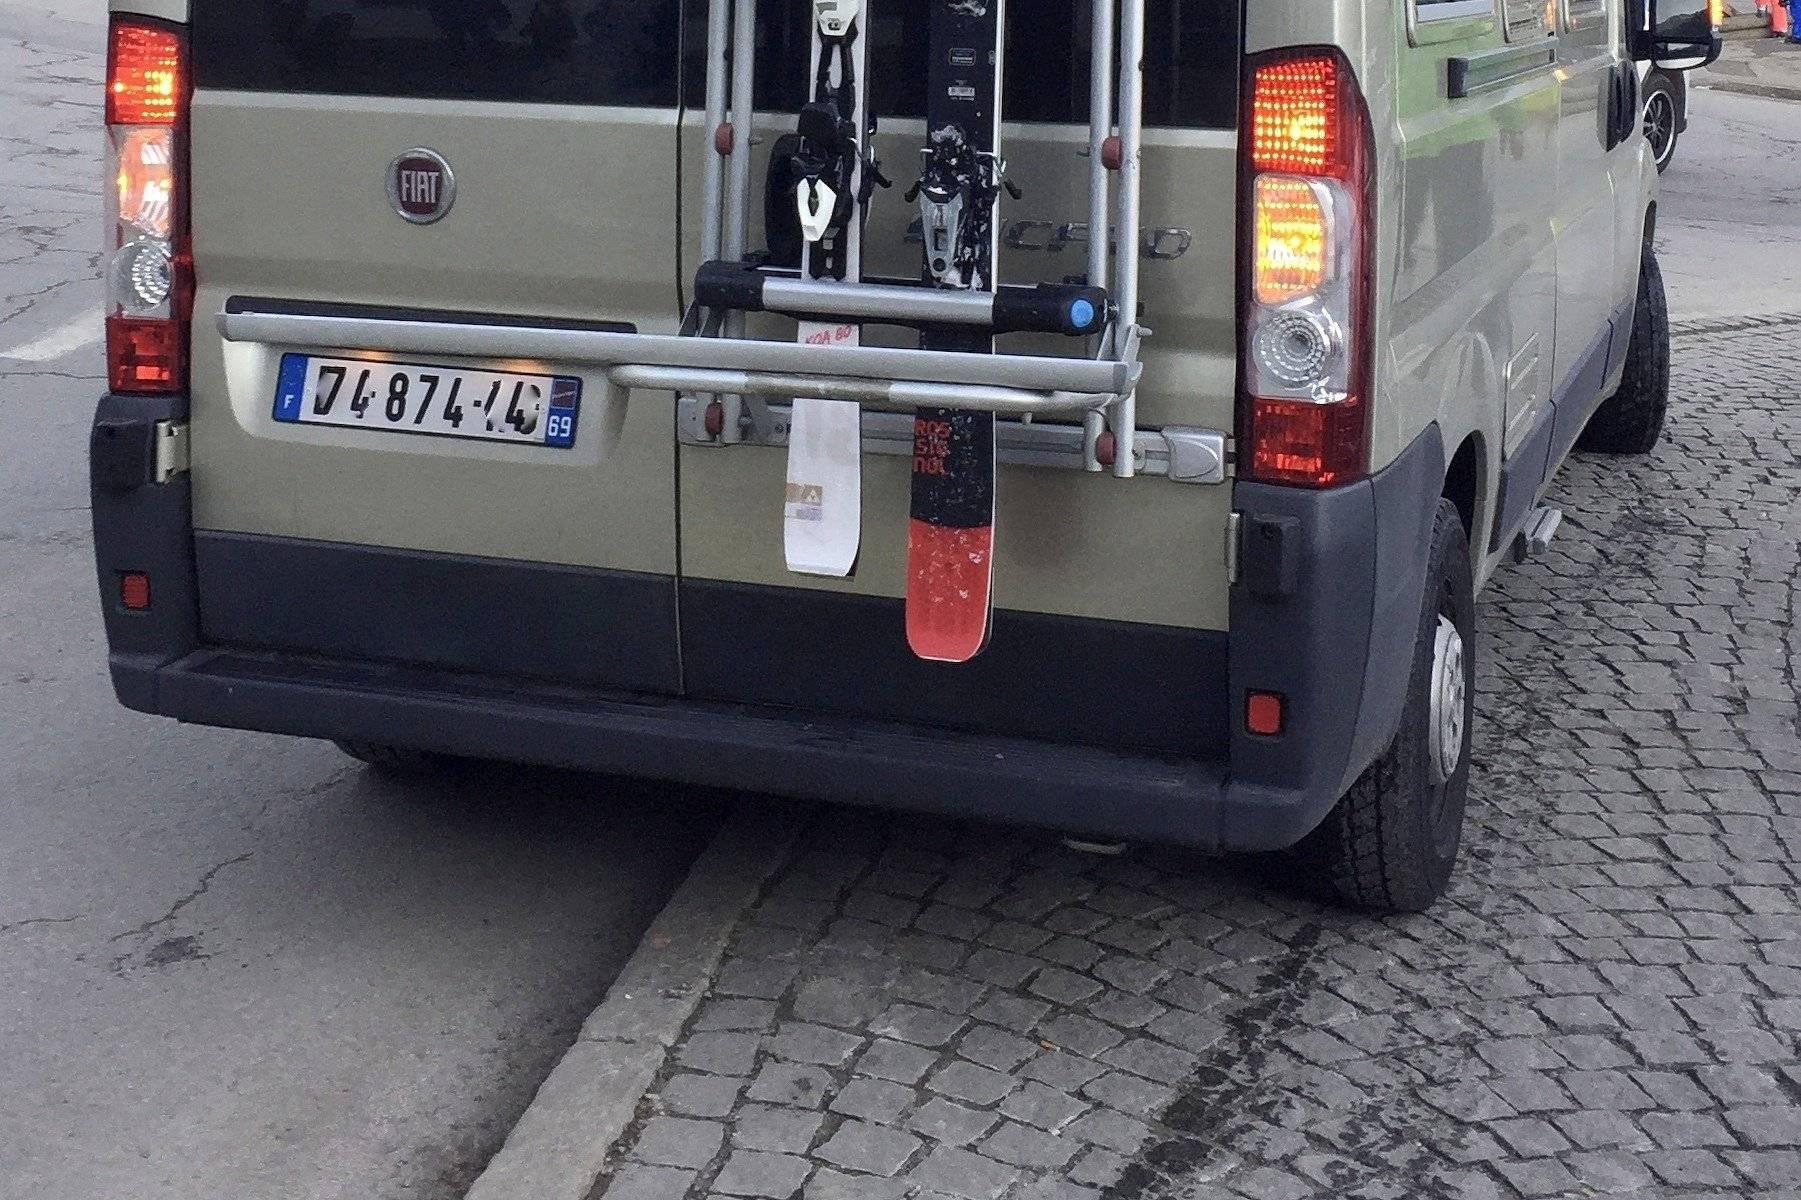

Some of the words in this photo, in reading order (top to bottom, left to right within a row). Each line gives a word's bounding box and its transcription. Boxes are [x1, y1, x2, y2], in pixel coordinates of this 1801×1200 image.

[401, 170, 440, 203] FIAT
[284, 394, 295, 409] F
[547, 415, 572, 438] 69
